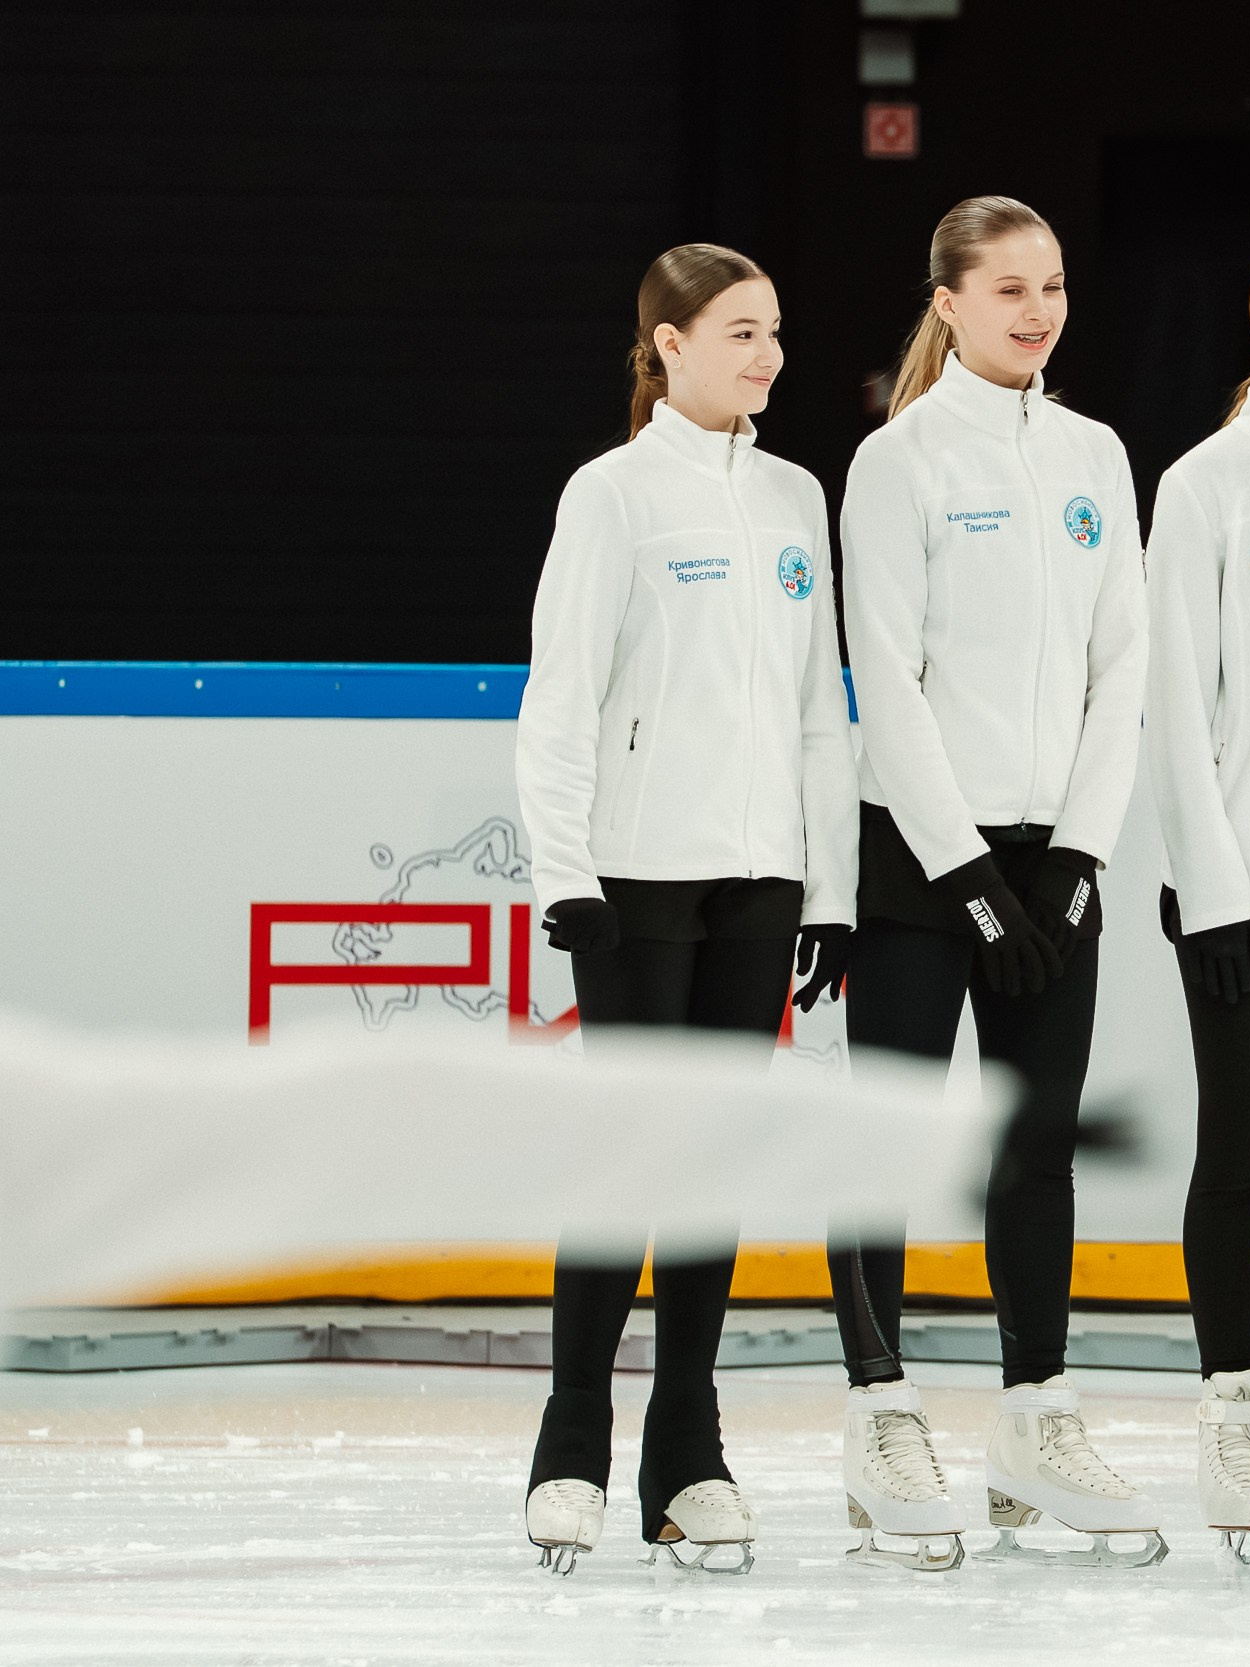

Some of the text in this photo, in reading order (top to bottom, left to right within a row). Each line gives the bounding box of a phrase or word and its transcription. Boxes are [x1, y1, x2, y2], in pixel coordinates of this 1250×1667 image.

[947, 509, 1010, 522] Калашникова
[964, 523, 999, 533] Таисия
[668, 557, 730, 572] Кривоногова
[676, 571, 726, 584] Ярослава
